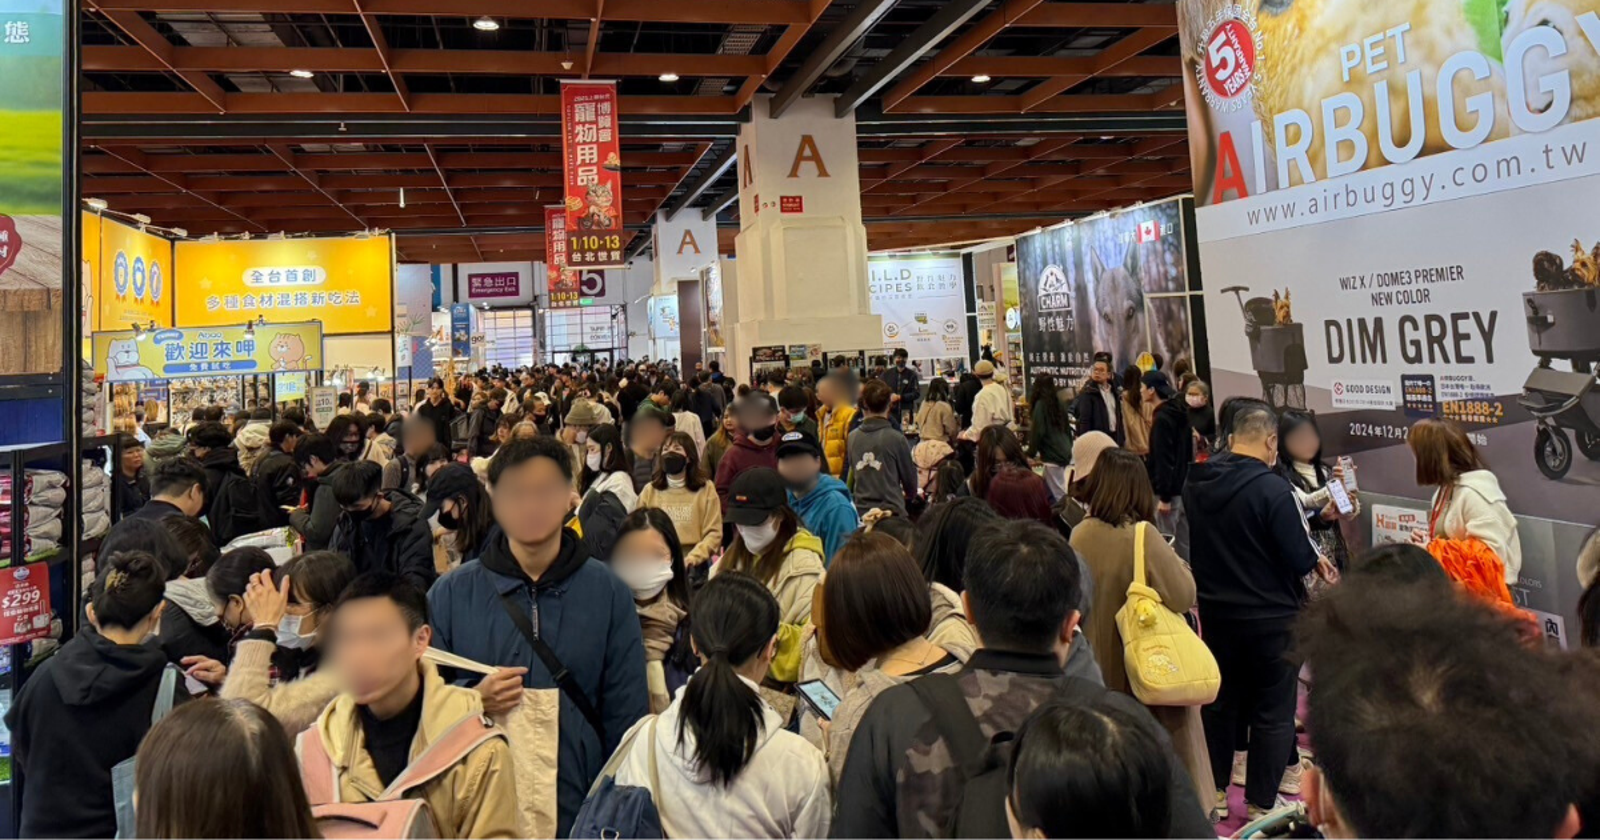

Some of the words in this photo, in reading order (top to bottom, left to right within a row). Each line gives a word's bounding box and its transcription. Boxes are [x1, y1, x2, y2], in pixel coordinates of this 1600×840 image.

[4, 21, 30, 44] 態
[1208, 30, 1236, 81] 5
[1225, 23, 1251, 78] WARRANTY
[1340, 22, 1413, 82] PET
[1195, 64, 1229, 113] WARRANTY
[1223, 68, 1247, 97] YEARS
[1231, 82, 1258, 112] YEARS
[574, 102, 599, 186] 寵物用品
[743, 144, 753, 189] A
[787, 134, 831, 178] A
[1246, 141, 1588, 226] www.airbuggy.com.tw
[677, 229, 701, 254] A
[571, 250, 621, 262] 台北世貿
[250, 268, 317, 284] 全台首創
[471, 276, 516, 288] 緊急出口
[581, 269, 603, 295] 5
[871, 269, 912, 282] I.L.D
[1339, 275, 1358, 291] WIZ
[1359, 274, 1367, 289] X
[1368, 271, 1374, 288] /
[1376, 269, 1412, 287] DOME3
[1414, 265, 1465, 284] PREMIER
[869, 283, 912, 294] CIPES
[1371, 291, 1393, 306] NEW
[1396, 288, 1431, 305] COLOR
[206, 291, 361, 310] 多種食材混搭新吃法
[1041, 293, 1069, 309] CHARM
[1038, 315, 1075, 332] 野性魅力
[1324, 316, 1388, 364] DIM
[1399, 310, 1499, 365] GREY
[165, 340, 255, 362] 歡迎來呷
[189, 361, 231, 372] 免費試吃
[1030, 366, 1059, 376] AUTHENTIC
[1060, 366, 1092, 376] NUTRITION
[1345, 384, 1364, 394] GOOD
[1365, 384, 1392, 394] DESIGN
[1442, 400, 1504, 416] EN1888-2
[1349, 422, 1408, 440] 2024年12月2
[1520, 577, 1542, 588] OLORS
[2, 589, 41, 609] $299
